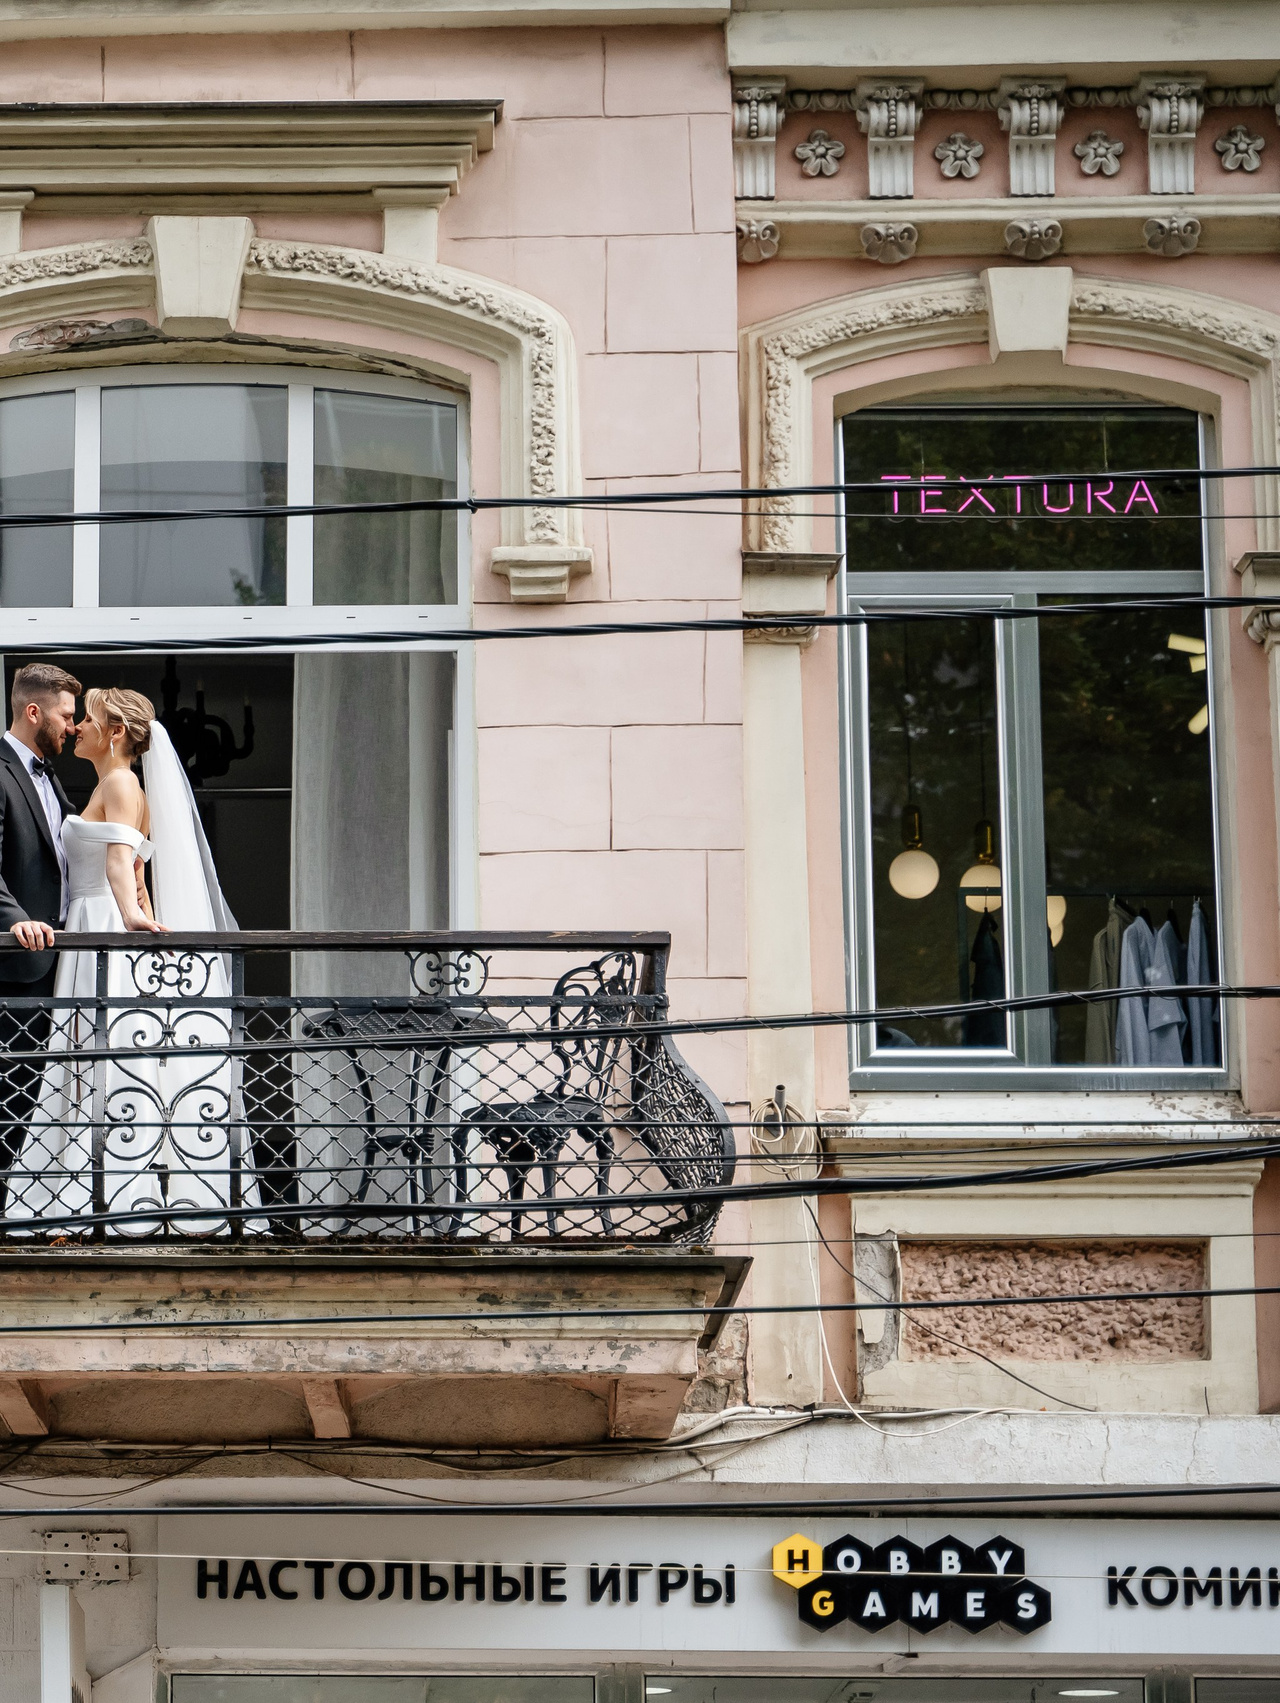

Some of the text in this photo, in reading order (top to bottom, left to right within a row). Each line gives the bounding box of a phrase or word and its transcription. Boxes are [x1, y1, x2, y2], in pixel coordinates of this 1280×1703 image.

[881, 475, 1159, 513] TEXTURA
[787, 1549, 1013, 1575] HOBBY
[195, 1558, 737, 1606] НАСТОЛЬНЫЕ ИГРЫ
[811, 1590, 1037, 1618] GAMES
